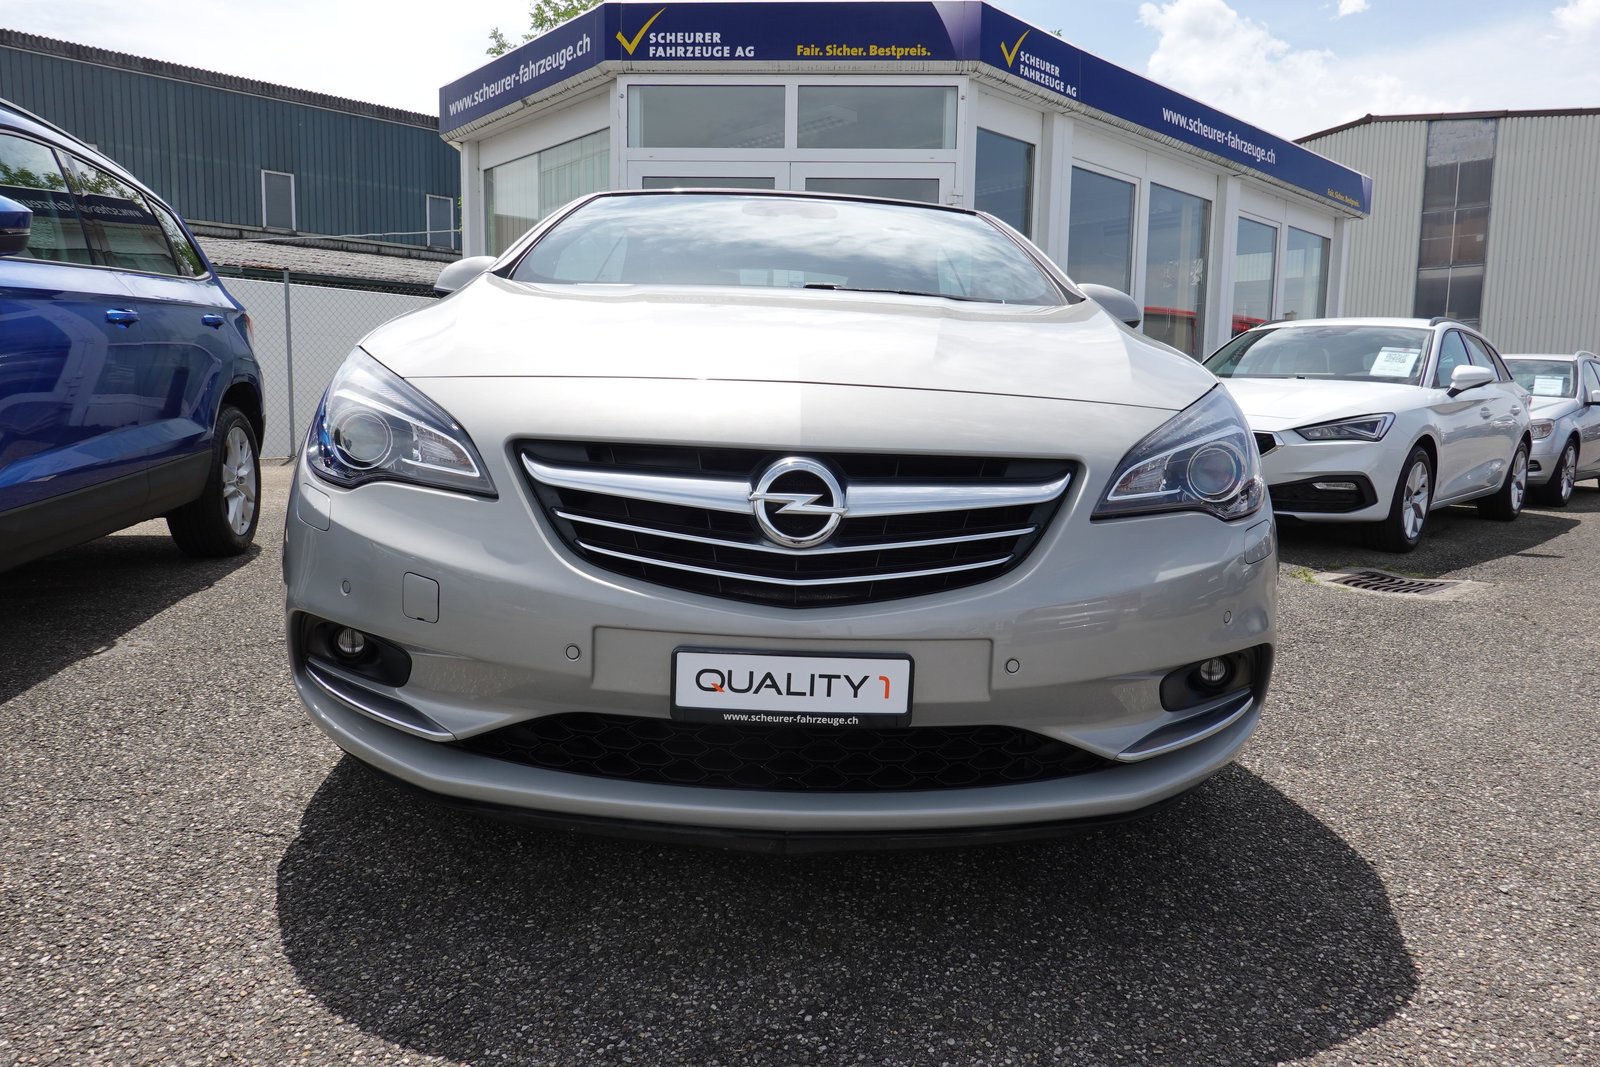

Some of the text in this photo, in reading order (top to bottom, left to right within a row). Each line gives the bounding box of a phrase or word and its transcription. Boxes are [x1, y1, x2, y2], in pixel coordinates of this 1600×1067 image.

[649, 32, 721, 44] SCHEURER
[649, 46, 755, 58] FAHRZEUGE AG
[796, 44, 931, 59] Fair. Sicher. Bestpreis.
[1020, 51, 1060, 77] SCHEURER
[449, 33, 591, 117] www.scheurer-fahrzeuge.ch
[1020, 64, 1077, 97] FAHRZEUGE AG
[1162, 107, 1276, 165] www.scheurer-fahrzeuge.ch
[695, 668, 891, 699] QUALITY 1
[723, 711, 859, 727] www.scheurer-fahrzeuge.ch
